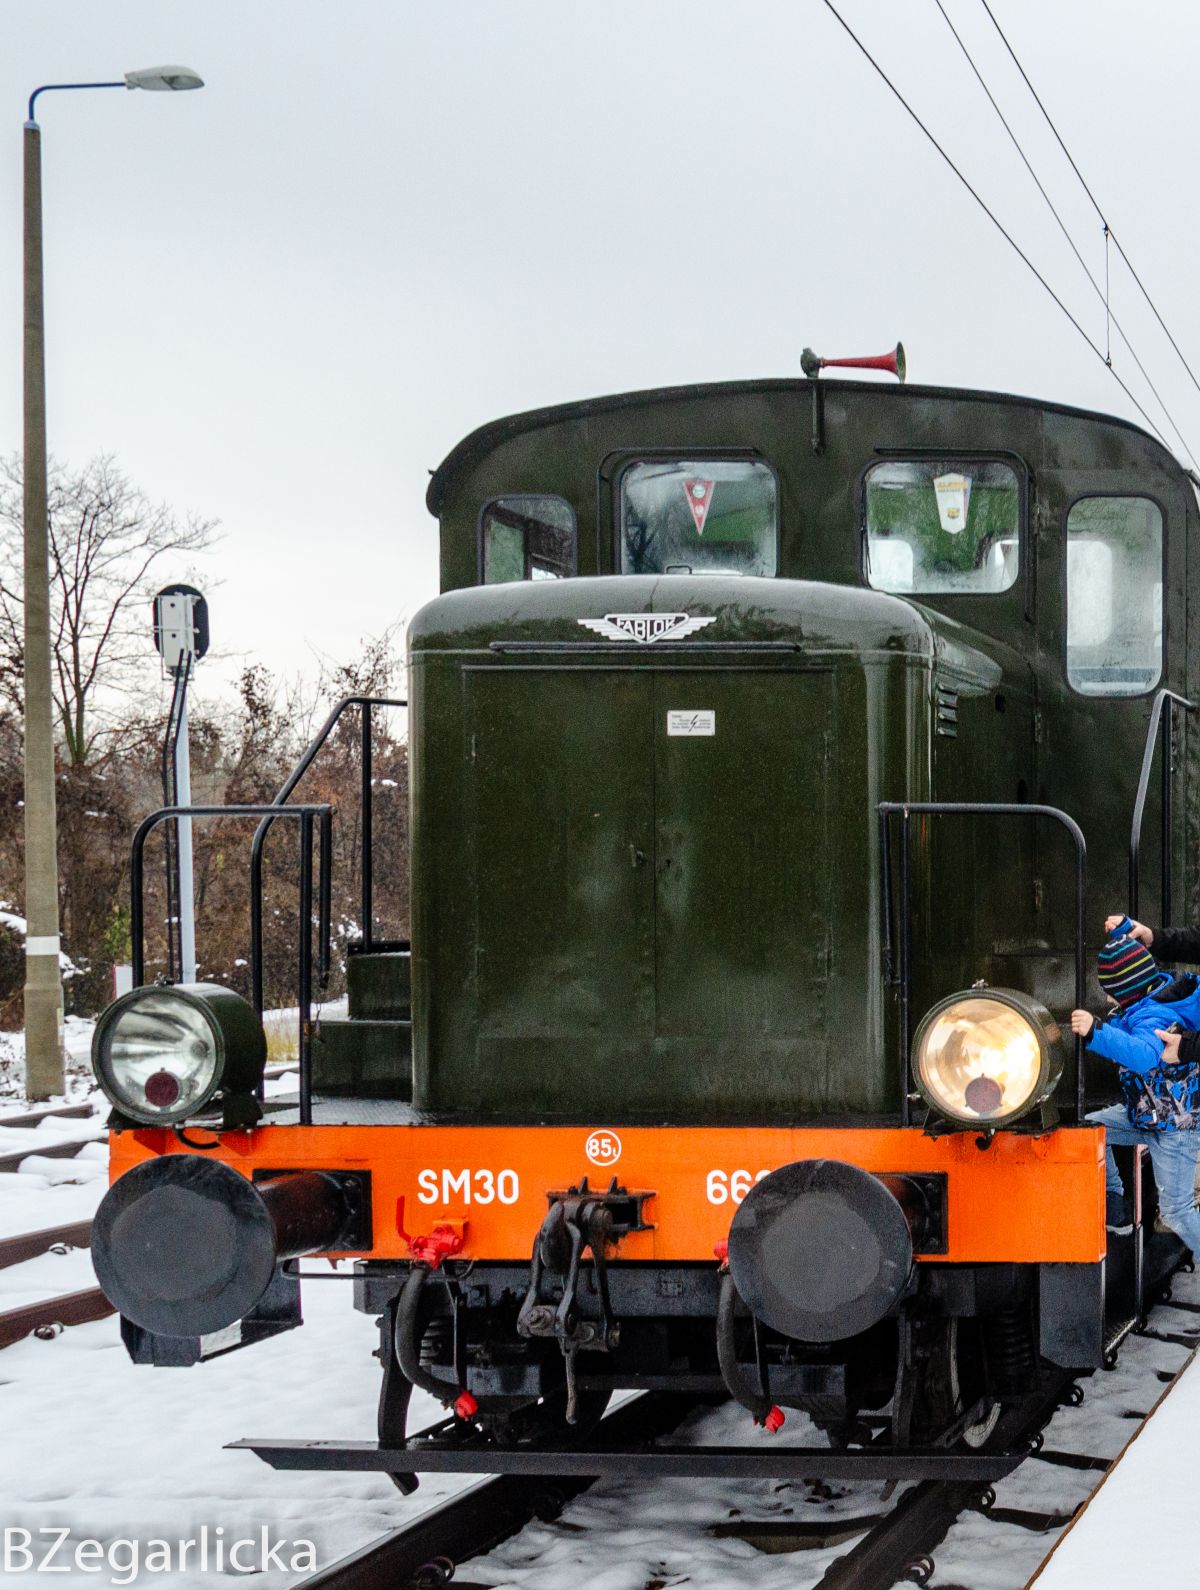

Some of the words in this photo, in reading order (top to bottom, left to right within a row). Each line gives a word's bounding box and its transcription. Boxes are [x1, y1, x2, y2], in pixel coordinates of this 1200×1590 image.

[616, 617, 677, 641] FABLOK
[417, 1168, 520, 1205] SM30
[706, 1169, 772, 1205] 66
